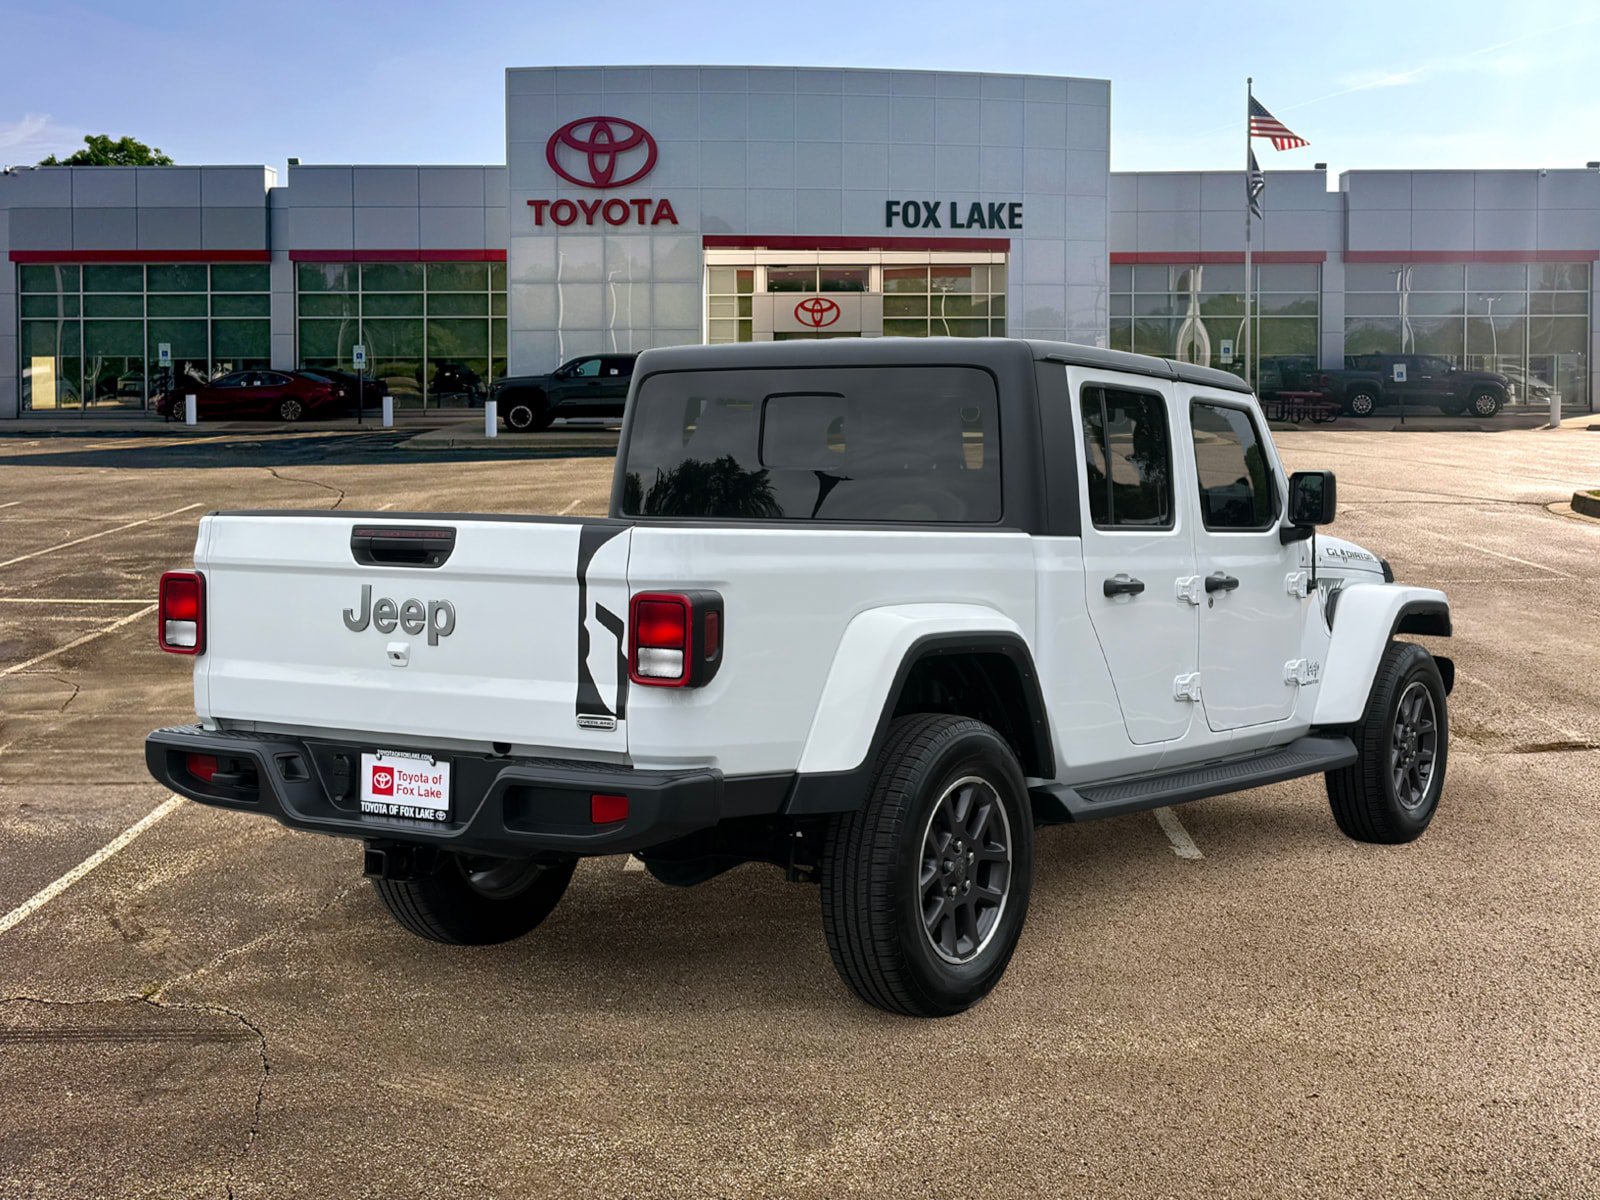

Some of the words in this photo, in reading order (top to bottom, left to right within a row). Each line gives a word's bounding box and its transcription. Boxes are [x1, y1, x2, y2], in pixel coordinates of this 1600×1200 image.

[527, 198, 679, 227] TOYOTA
[885, 200, 942, 229] FOX
[950, 201, 1023, 230] LAKE
[342, 583, 456, 647] Jeep
[397, 770, 429, 785] Toyota
[432, 774, 443, 785] of
[396, 784, 415, 796] Fox
[417, 785, 442, 799] Lake
[361, 802, 388, 815] TOYOTA
[389, 805, 400, 816] OF
[400, 807, 415, 818] FOX
[415, 808, 435, 820] LAKE
